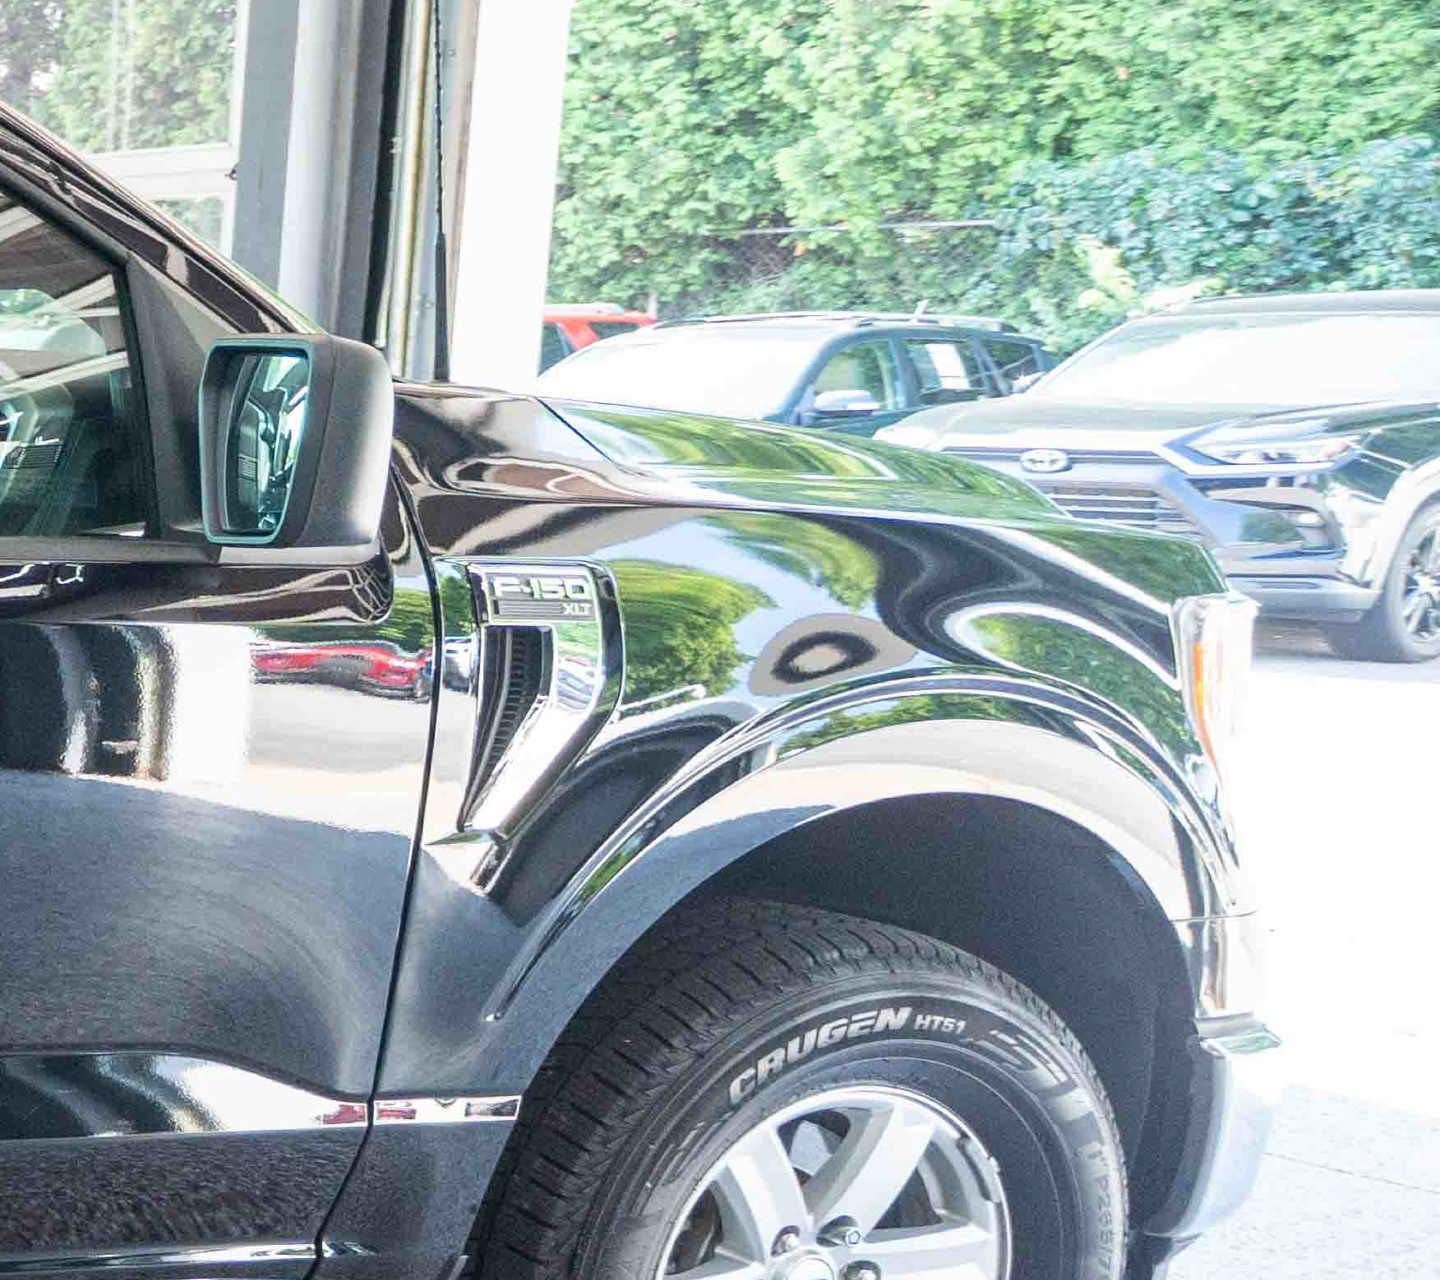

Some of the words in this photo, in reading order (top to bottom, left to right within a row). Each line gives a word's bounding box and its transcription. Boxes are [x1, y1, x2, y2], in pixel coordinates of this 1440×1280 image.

[493, 576, 592, 600] F-150
[562, 602, 592, 616] XLT
[729, 1006, 912, 1104] CRUGEN
[913, 1014, 967, 1035] HT51
